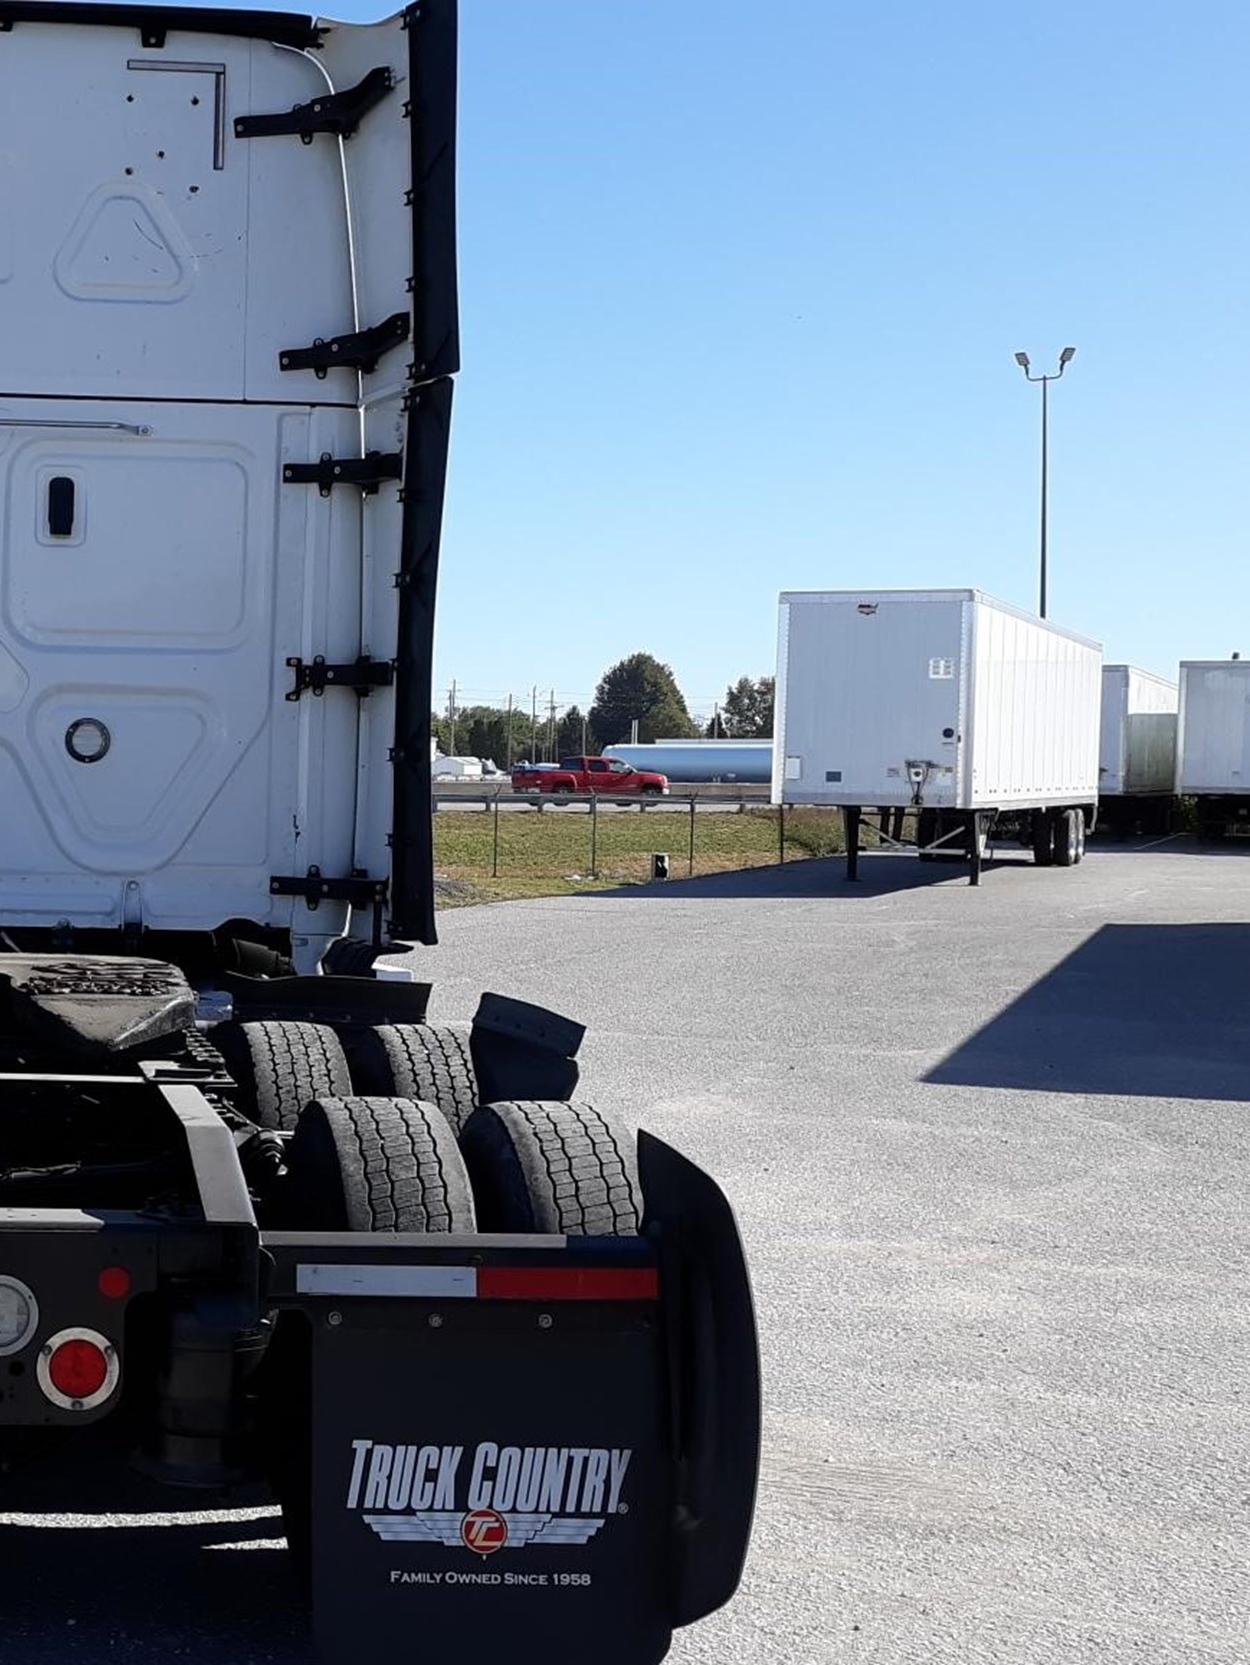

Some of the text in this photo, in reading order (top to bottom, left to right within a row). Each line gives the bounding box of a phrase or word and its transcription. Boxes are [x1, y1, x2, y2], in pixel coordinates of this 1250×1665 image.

[346, 1440, 463, 1510] TRUCK
[390, 1570, 592, 1586] FAMILY OWNED SINCE 1958
